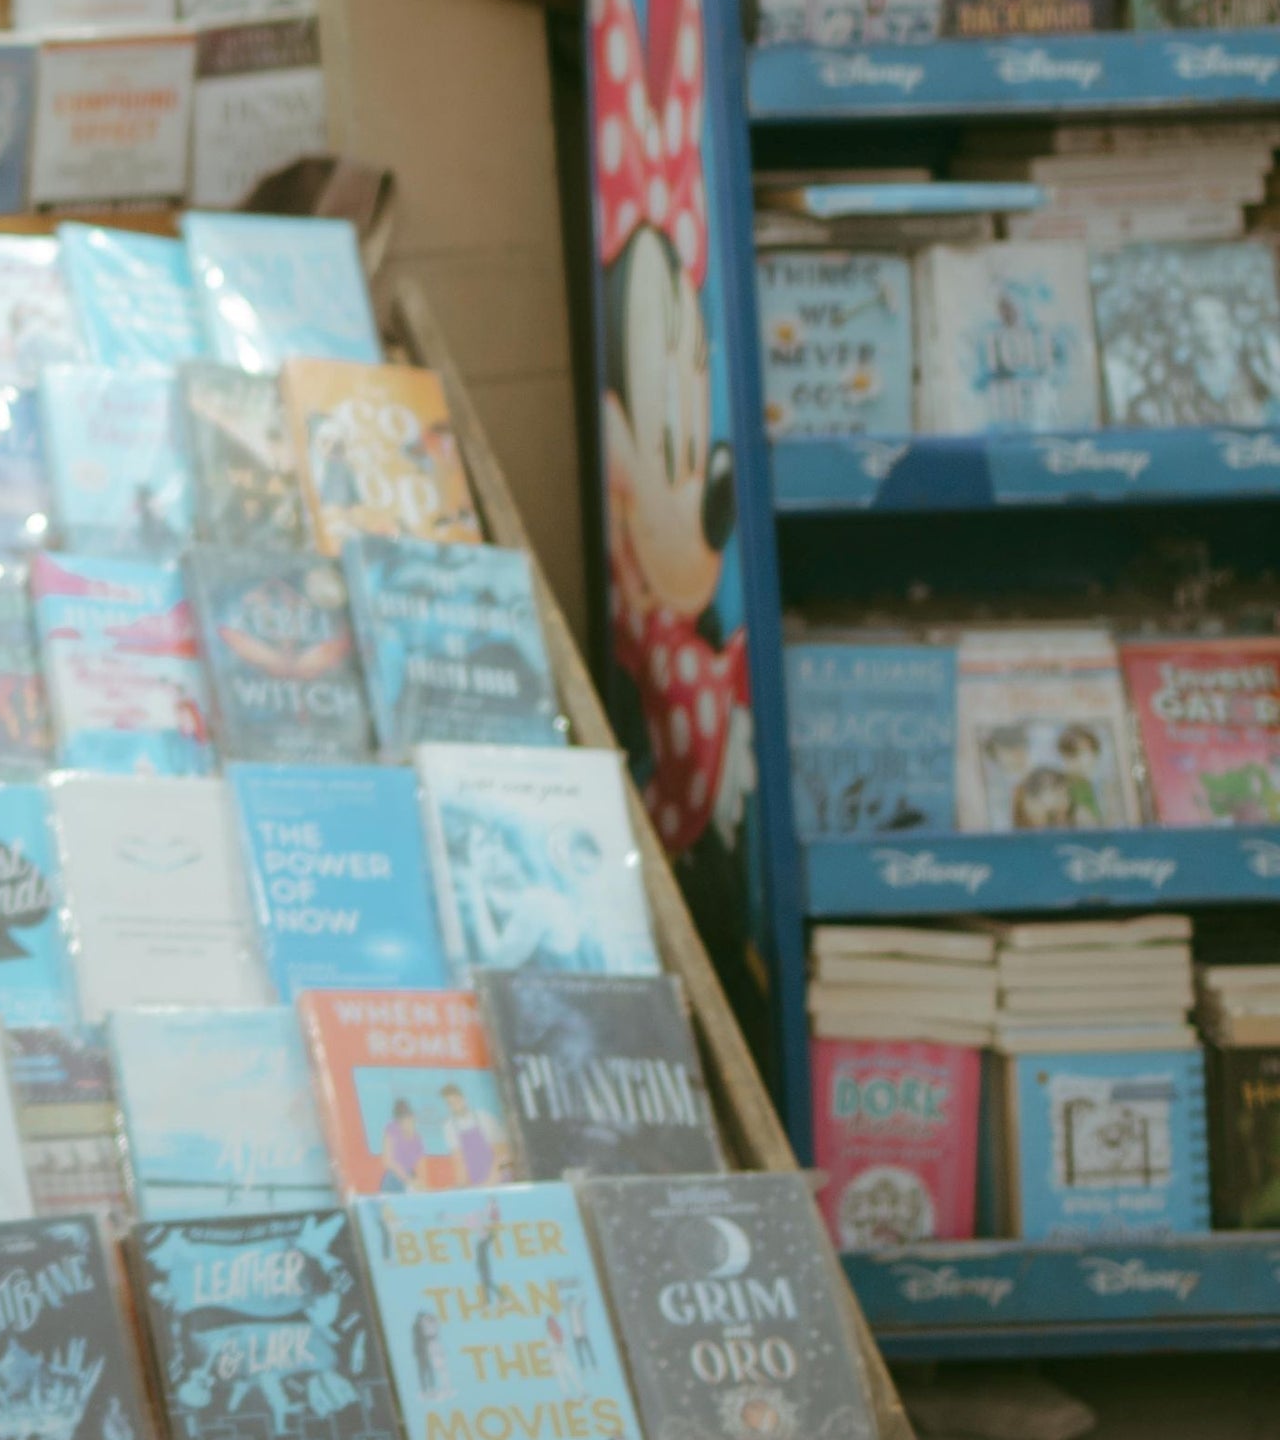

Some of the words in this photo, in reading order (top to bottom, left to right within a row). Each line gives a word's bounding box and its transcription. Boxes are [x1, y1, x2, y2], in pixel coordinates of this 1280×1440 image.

[810, 48, 925, 92] Disney
[986, 45, 1103, 89] Disney
[1163, 42, 1279, 84] Disney
[1032, 436, 1151, 480] Disney
[1210, 432, 1280, 471] Dis
[235, 677, 361, 717] WITCH
[256, 822, 324, 850] THE
[264, 849, 394, 881] POWER
[871, 847, 995, 897] Disney
[1055, 842, 1178, 891] Disney
[270, 878, 320, 906] OF
[273, 907, 362, 935] NOW
[332, 996, 435, 1026] WHEN
[365, 1028, 469, 1060] ROME
[831, 1072, 950, 1122] DORK
[394, 1220, 569, 1267] BETTER
[191, 1249, 305, 1304] LEATHER
[891, 1264, 1014, 1308] Disney
[1078, 1256, 1202, 1302] Disney
[421, 1278, 563, 1325] THAN
[657, 1275, 800, 1326] GRIM
[248, 1326, 318, 1374] LARK
[459, 1340, 557, 1383] THE
[690, 1334, 800, 1387] ORO
